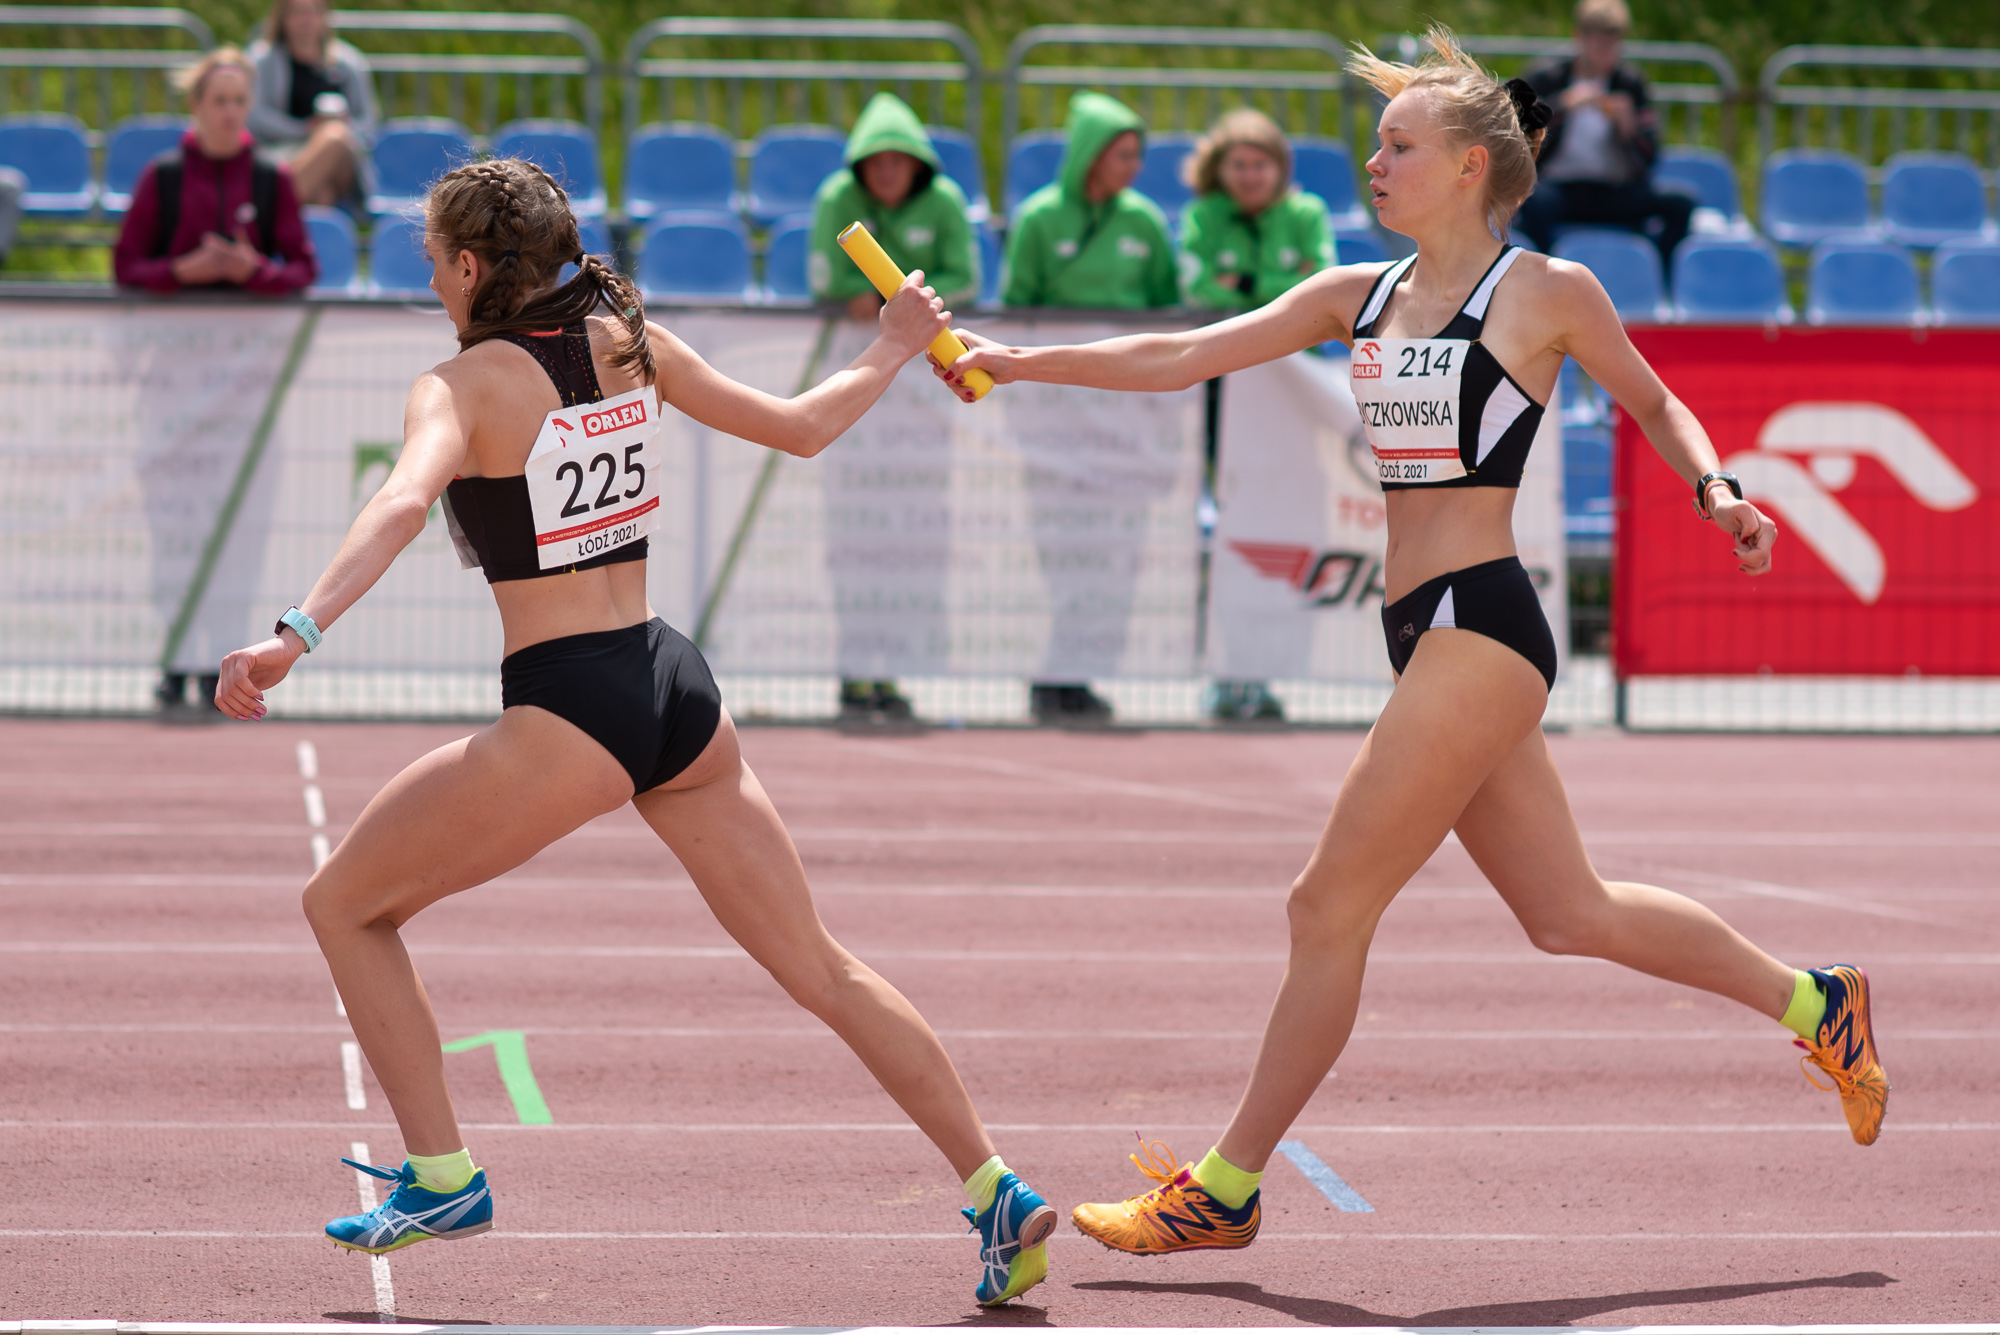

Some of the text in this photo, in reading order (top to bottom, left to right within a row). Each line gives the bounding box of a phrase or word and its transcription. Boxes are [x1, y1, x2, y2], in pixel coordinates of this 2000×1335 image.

[1354, 365, 1380, 377] ORLEN
[1397, 346, 1453, 377] 214
[586, 403, 643, 434] ORLEN
[555, 441, 646, 519] 225
[1403, 464, 1428, 479] 2021
[578, 523, 637, 557] ŁÓDŹ 2021
